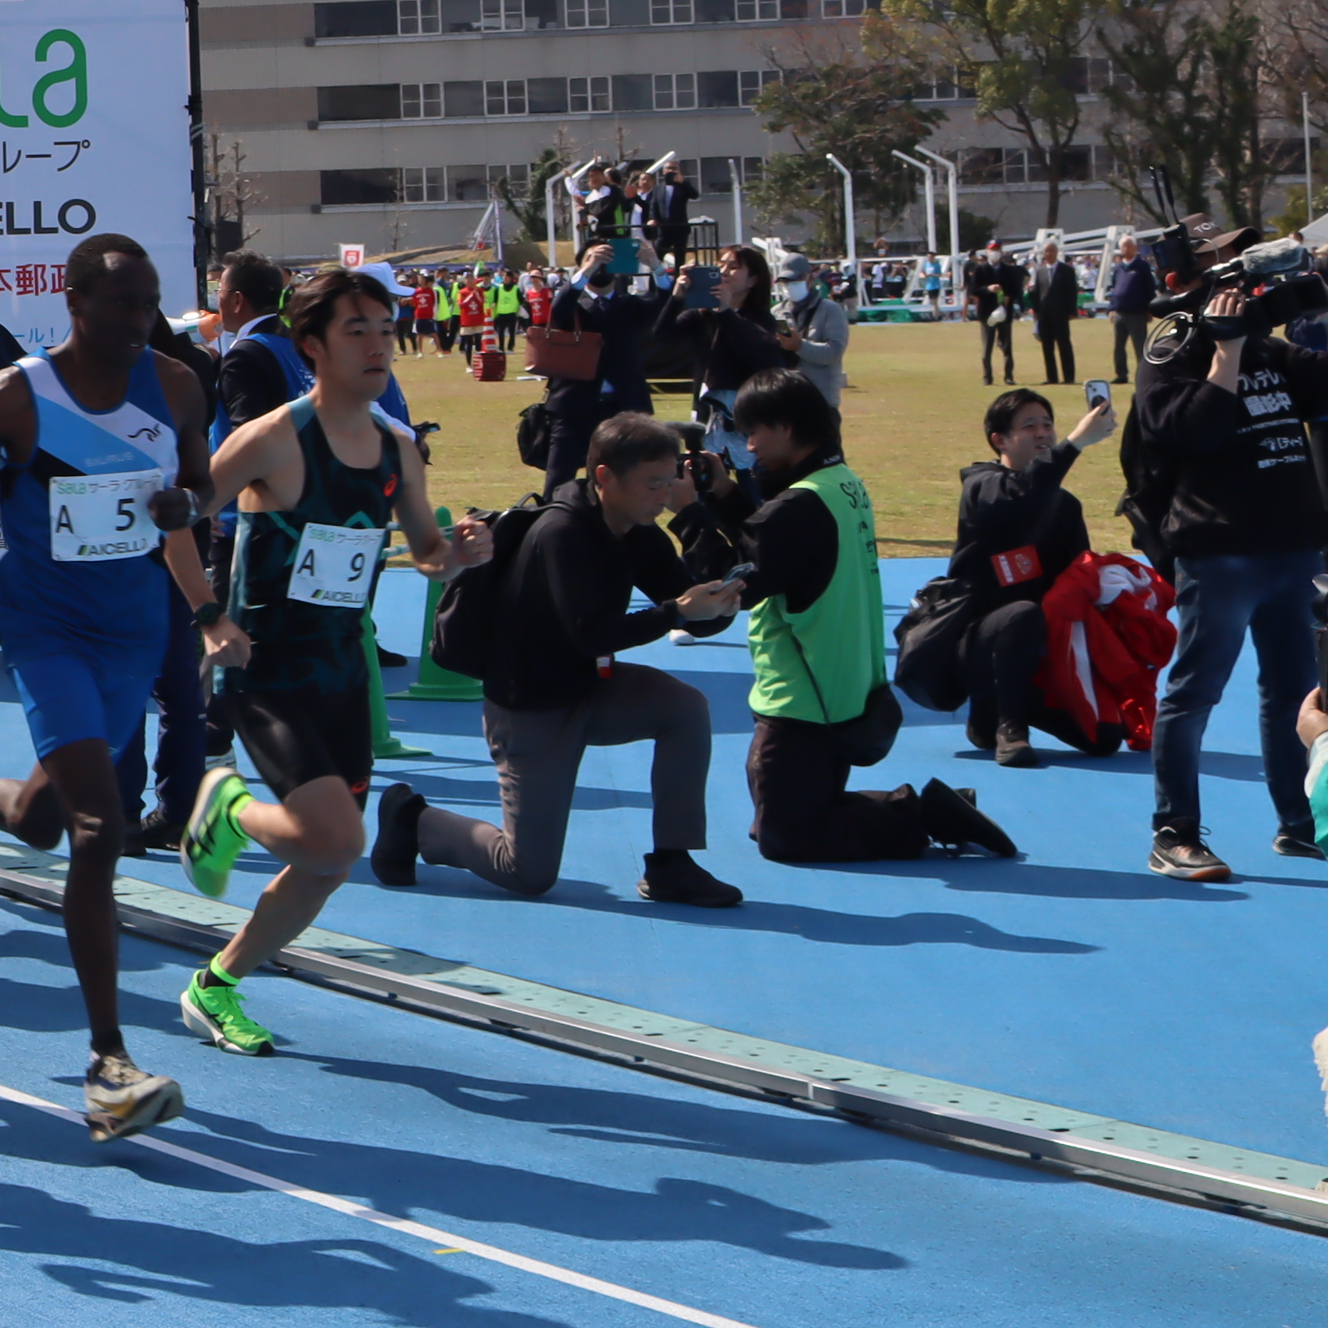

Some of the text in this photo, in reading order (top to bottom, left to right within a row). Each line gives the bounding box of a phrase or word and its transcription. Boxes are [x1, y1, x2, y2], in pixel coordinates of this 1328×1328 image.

[55, 497, 136, 534] A 5
[296, 548, 366, 582] A 9
